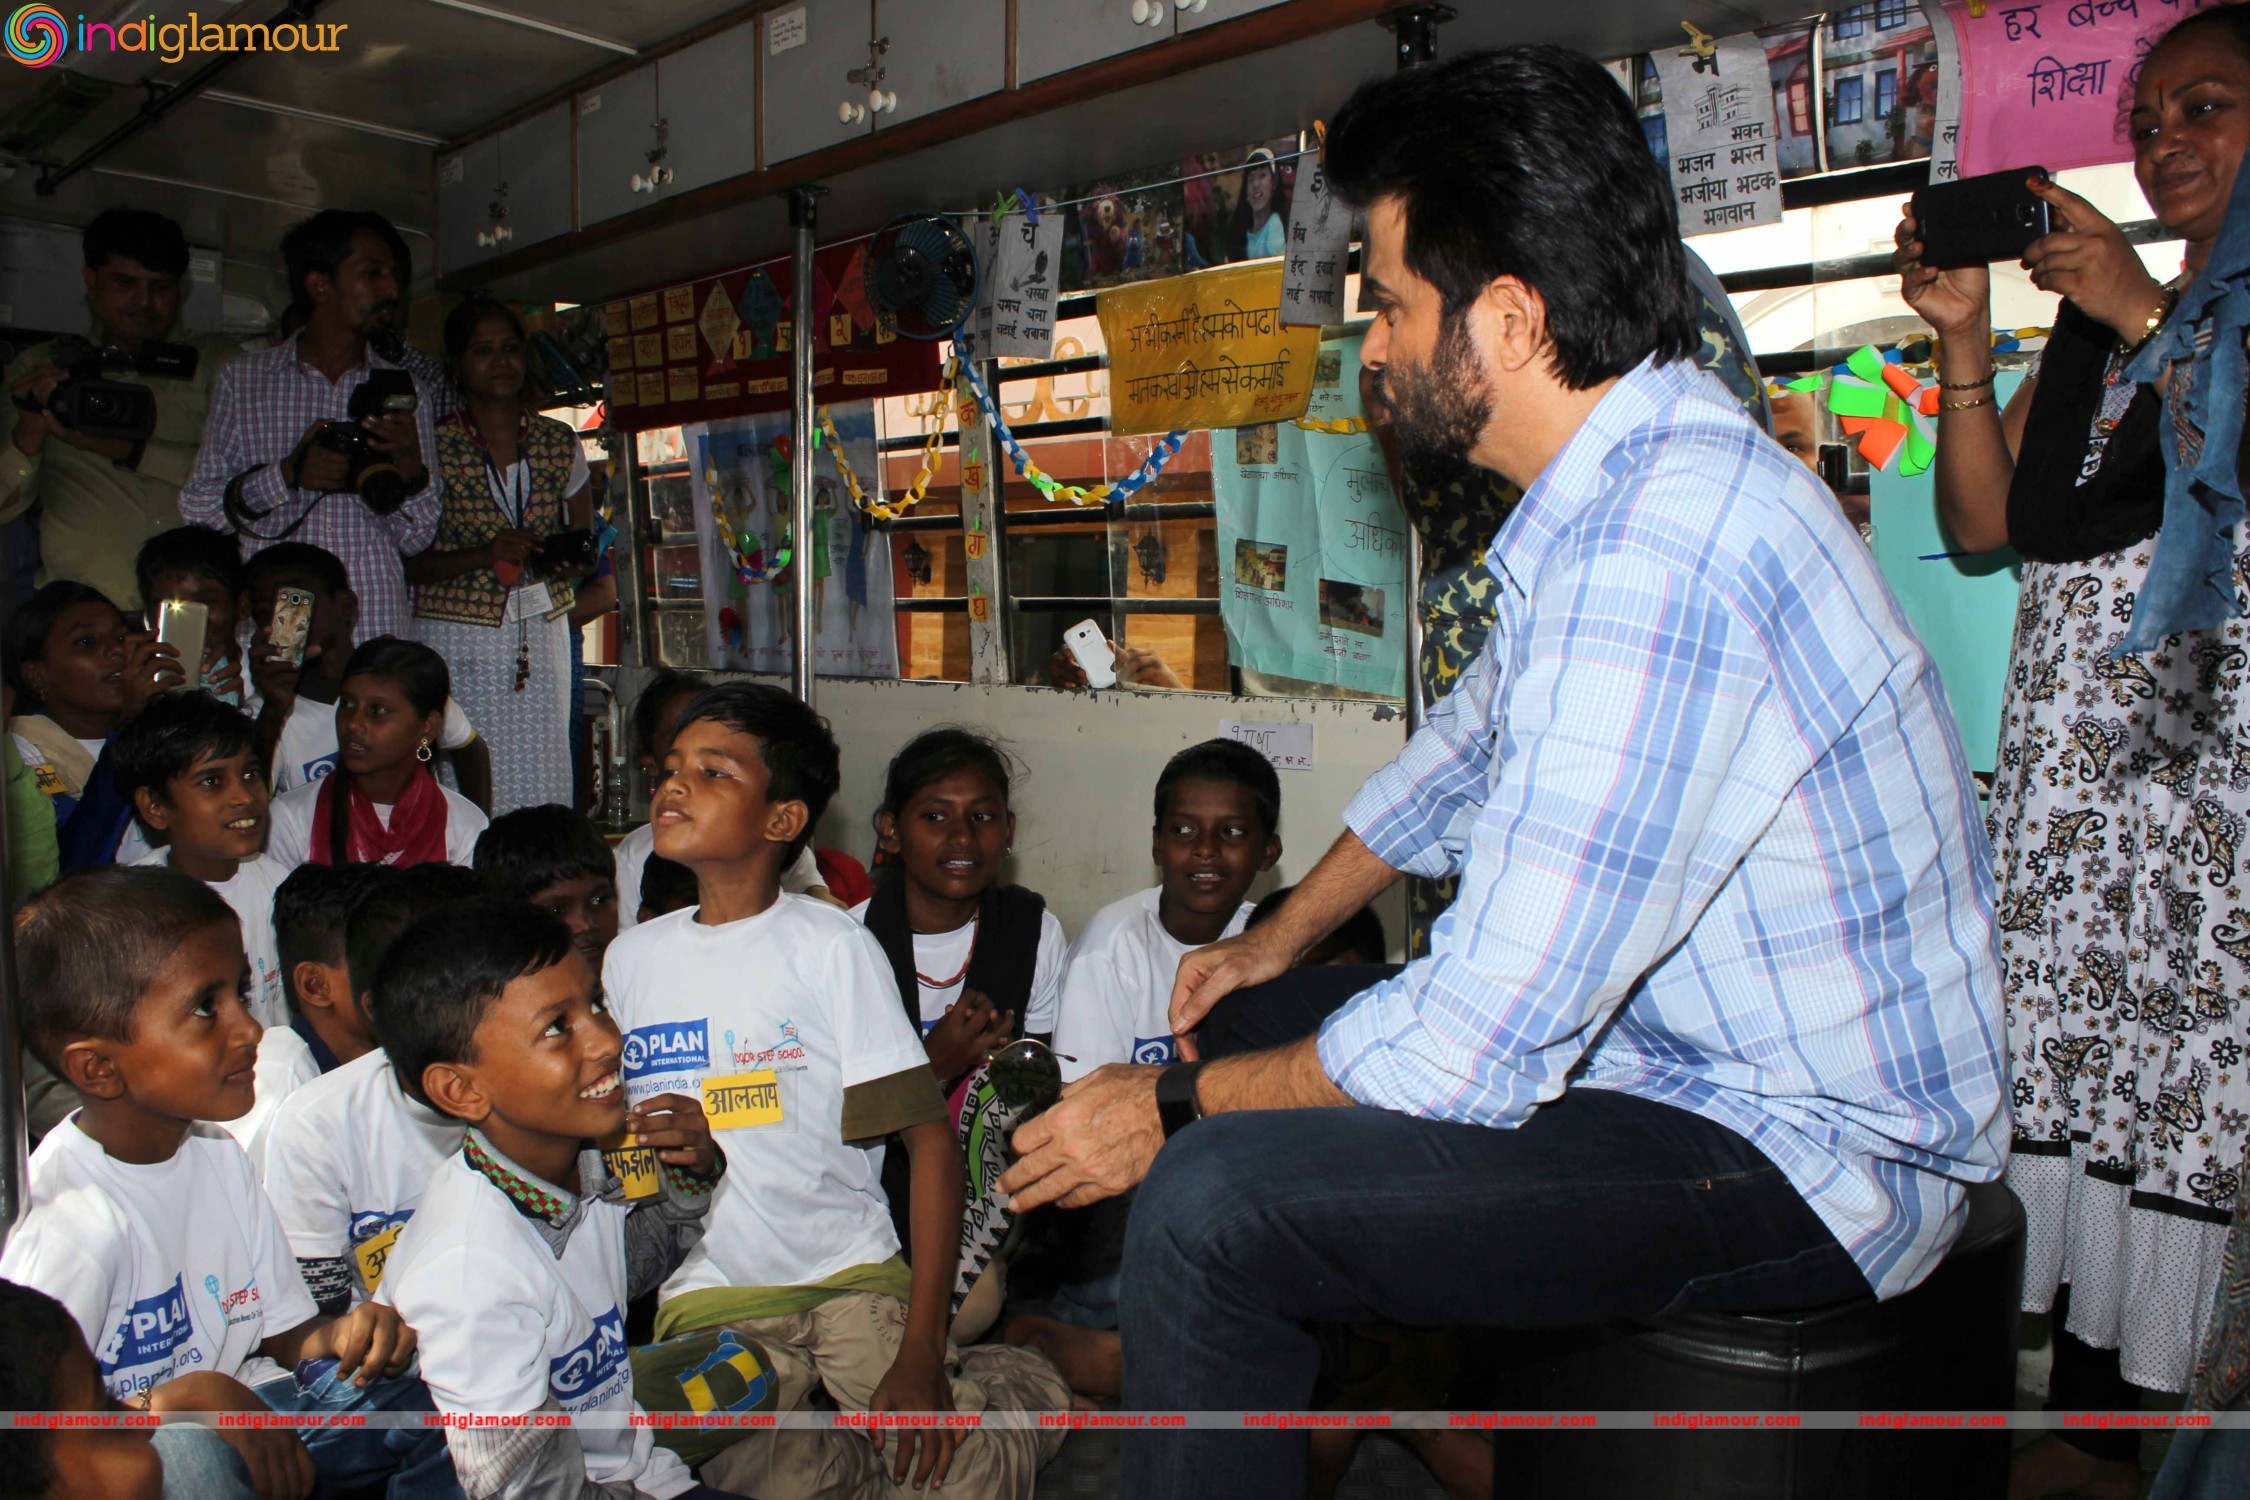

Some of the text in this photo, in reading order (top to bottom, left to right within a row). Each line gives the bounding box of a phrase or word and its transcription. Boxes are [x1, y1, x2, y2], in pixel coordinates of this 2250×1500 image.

[1999, 4, 2042, 42] हर
[2027, 55, 2112, 108] शिक्षा
[1731, 122, 1765, 141] भवन
[1678, 143, 1767, 174] भजन भरत
[1736, 171, 1776, 195] भटक
[1703, 201, 1756, 226] भगवान
[959, 402, 975, 426] क
[963, 465, 982, 491] ख
[967, 534, 984, 556] ग
[1344, 511, 1405, 561] अधिका
[972, 597, 988, 619] घ
[649, 1030, 704, 1056] PLAN
